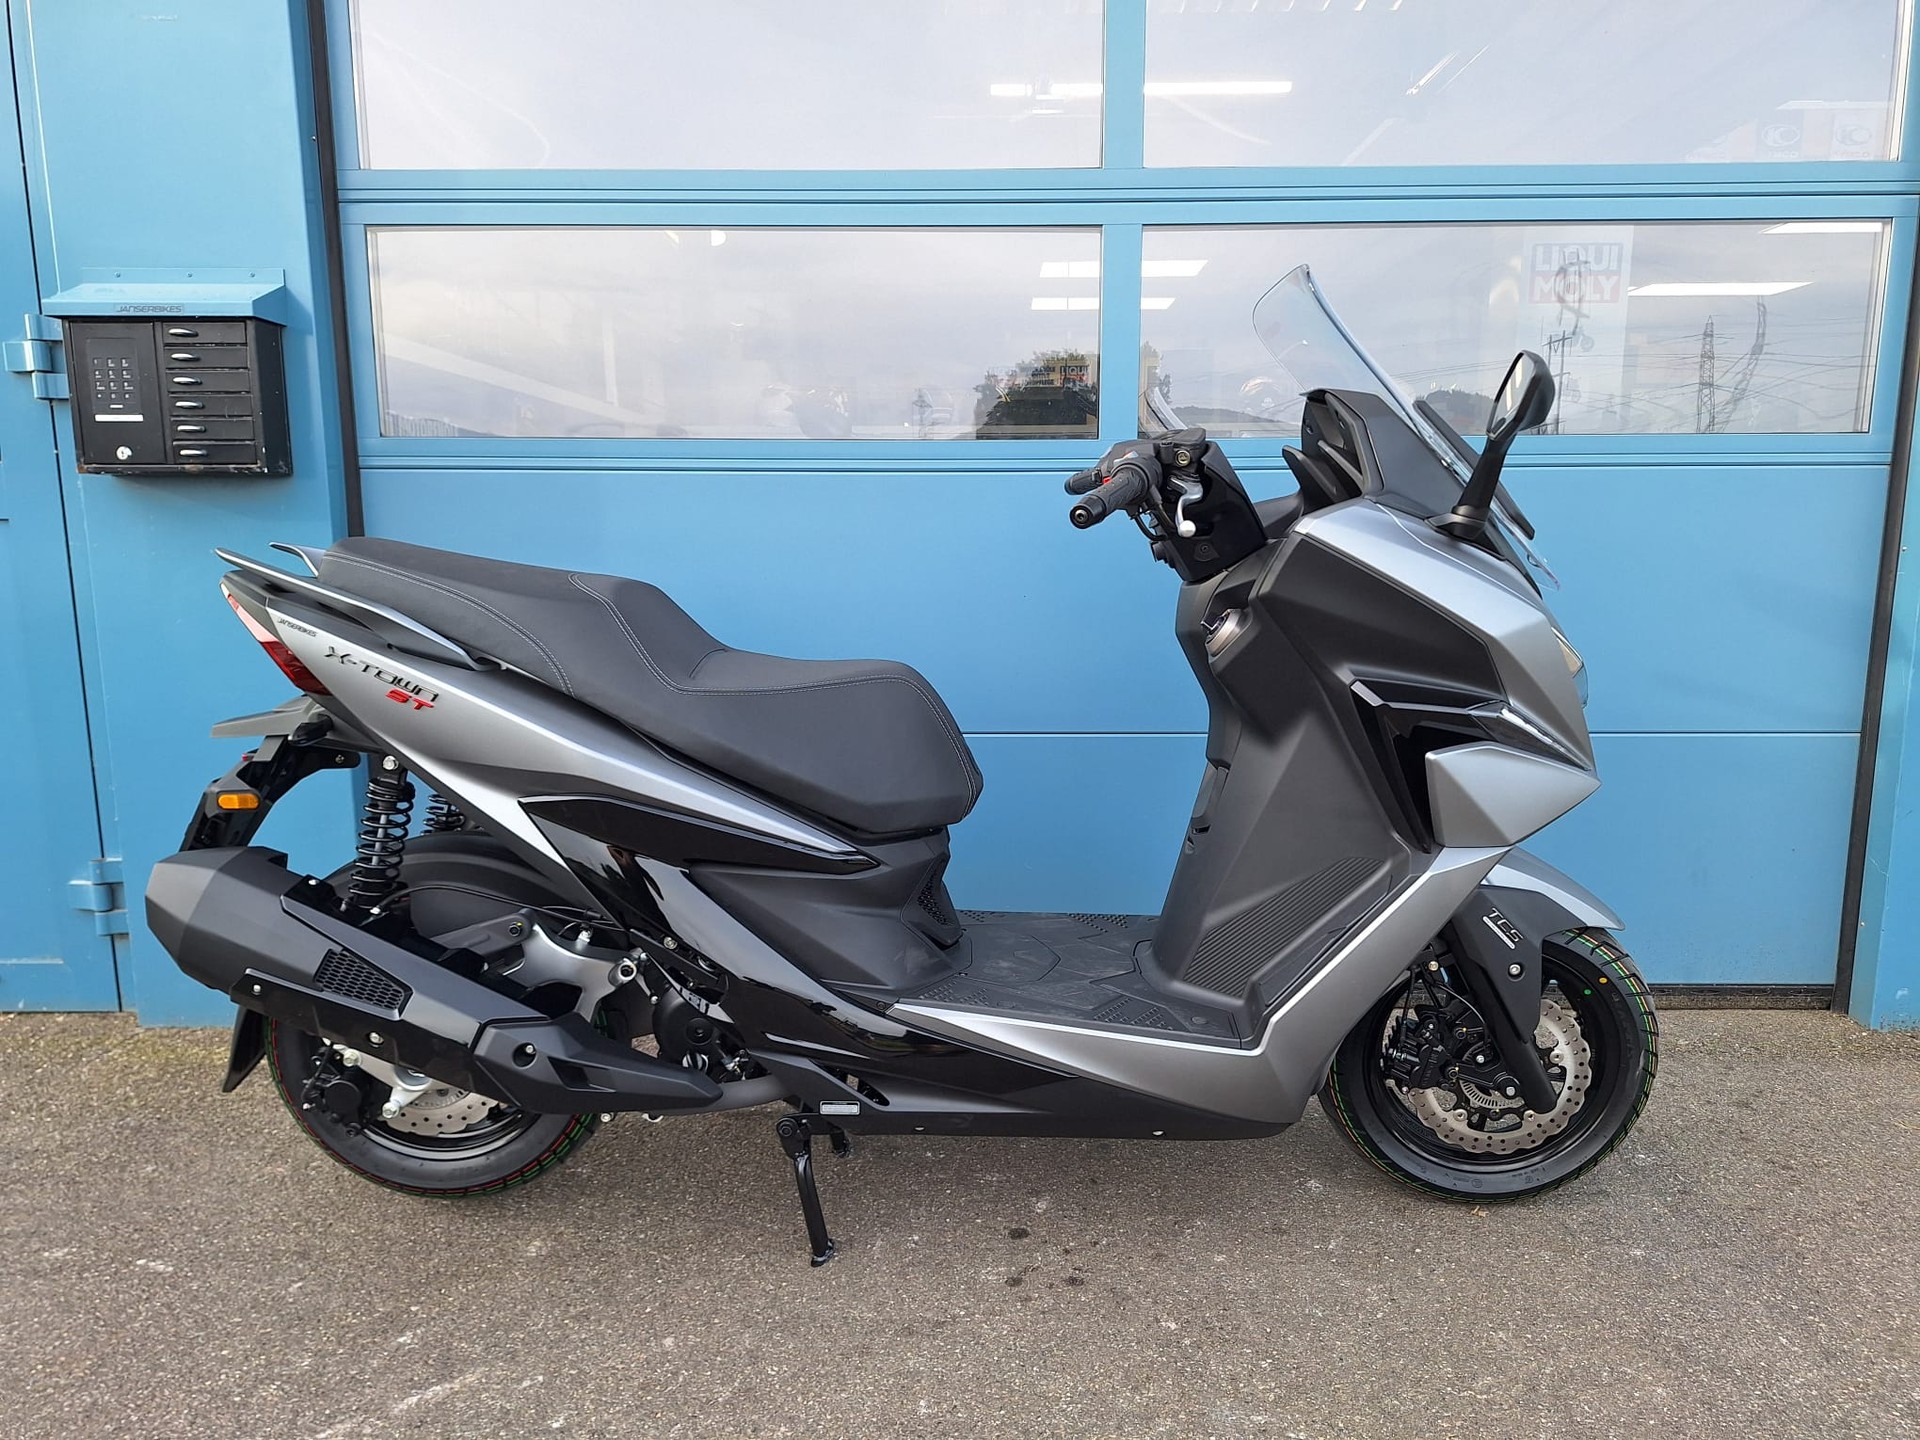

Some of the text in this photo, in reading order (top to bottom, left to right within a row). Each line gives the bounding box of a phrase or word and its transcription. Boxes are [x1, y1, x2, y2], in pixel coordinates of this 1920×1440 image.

[1535, 245, 1619, 271] LIQUI
[1534, 275, 1618, 301] MOLY
[116, 305, 182, 313] JANSERBIKES
[385, 688, 434, 710] ST
[1489, 907, 1524, 942] TCS
